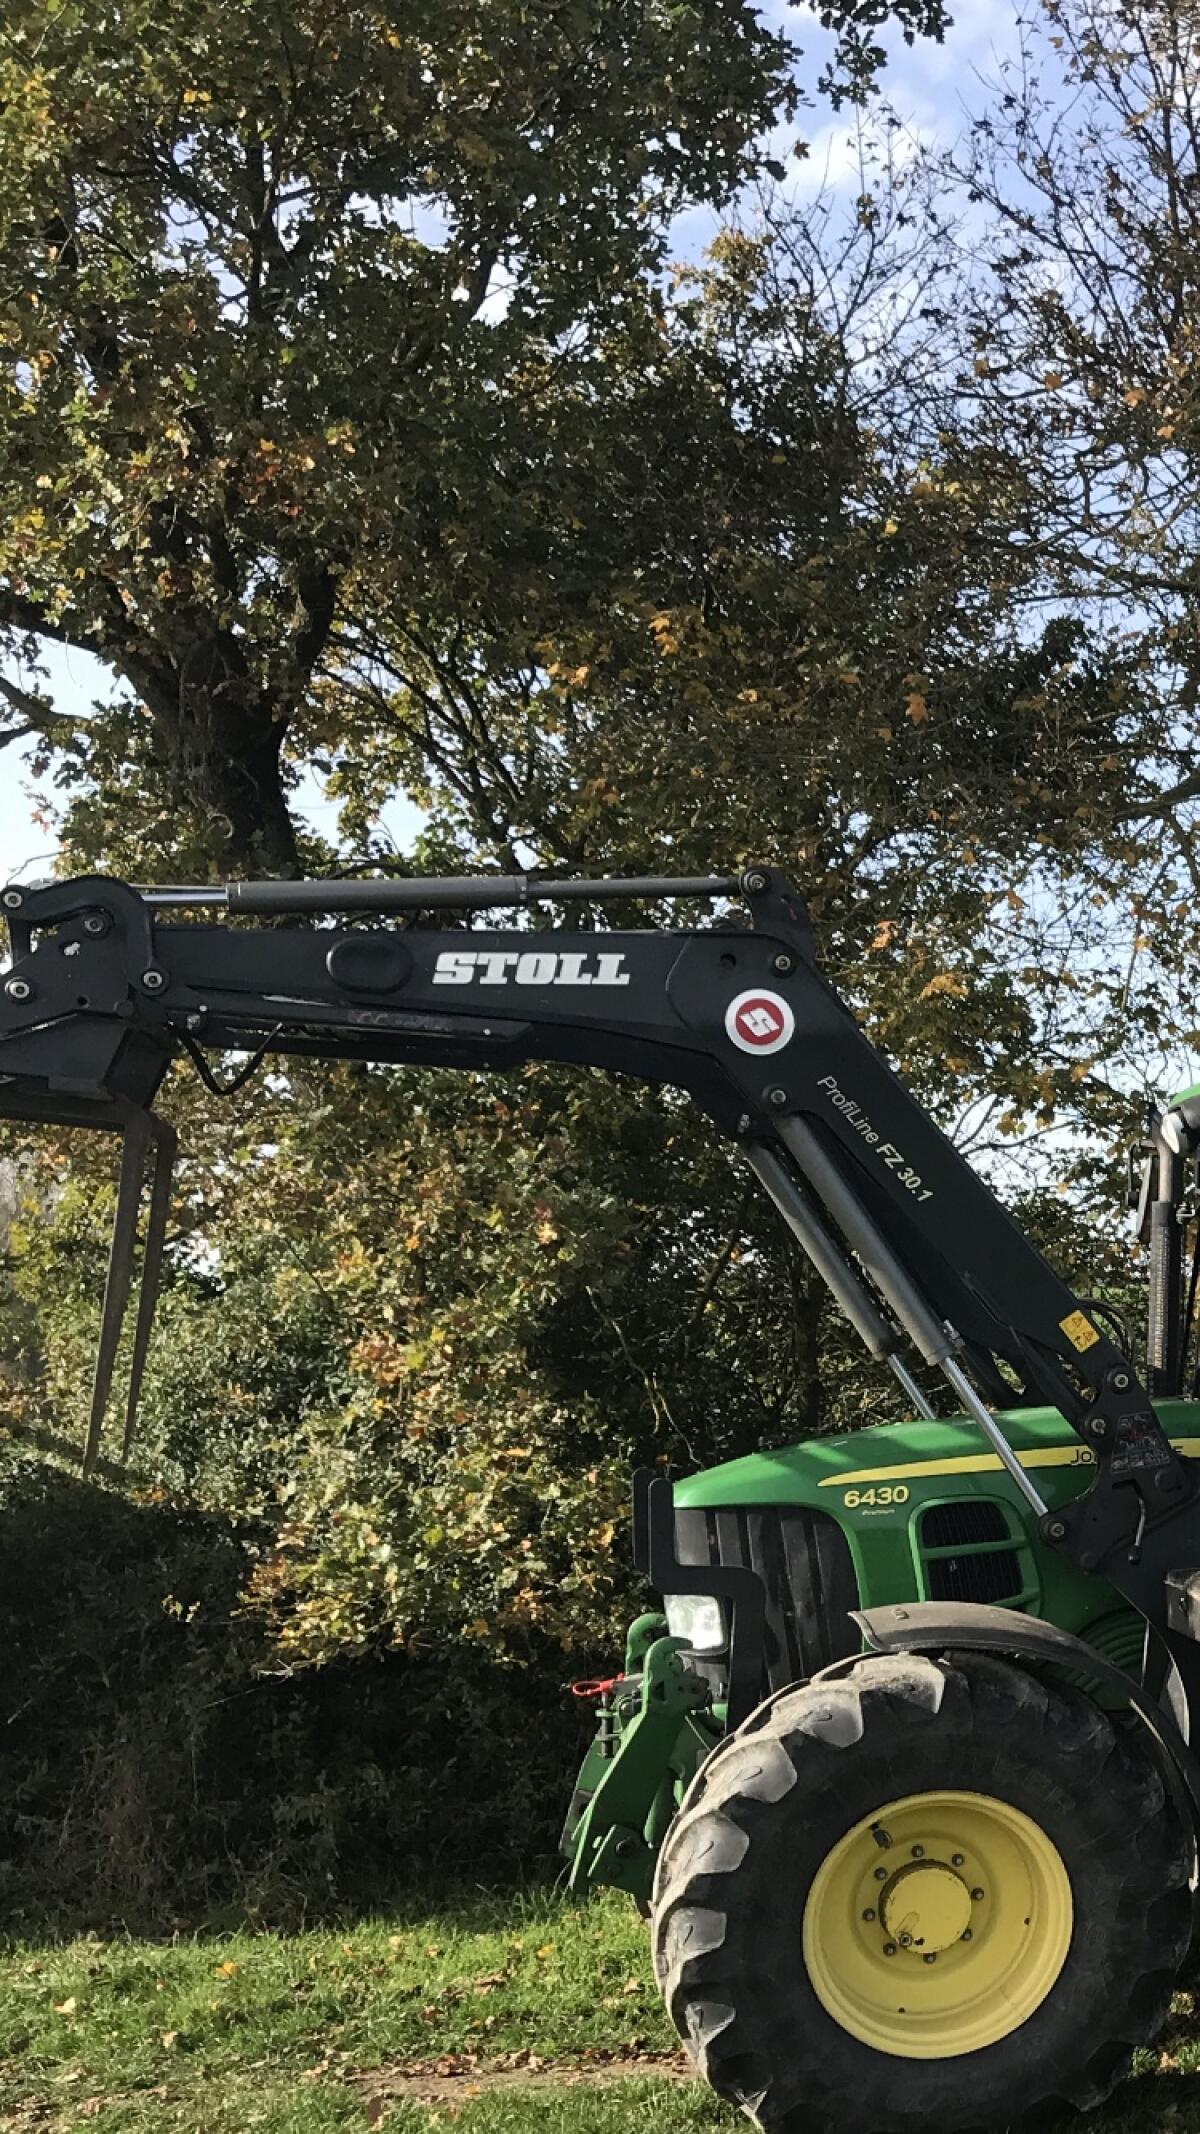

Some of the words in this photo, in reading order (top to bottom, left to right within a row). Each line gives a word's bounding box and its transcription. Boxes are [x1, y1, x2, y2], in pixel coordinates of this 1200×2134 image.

[432, 952, 630, 985] STOLL
[817, 1075, 880, 1144] ProfiLine
[875, 1143, 905, 1169] FZ
[897, 1167, 934, 1202] 30.1
[1071, 1449, 1097, 1463] JO
[844, 1485, 909, 1508] 6430
